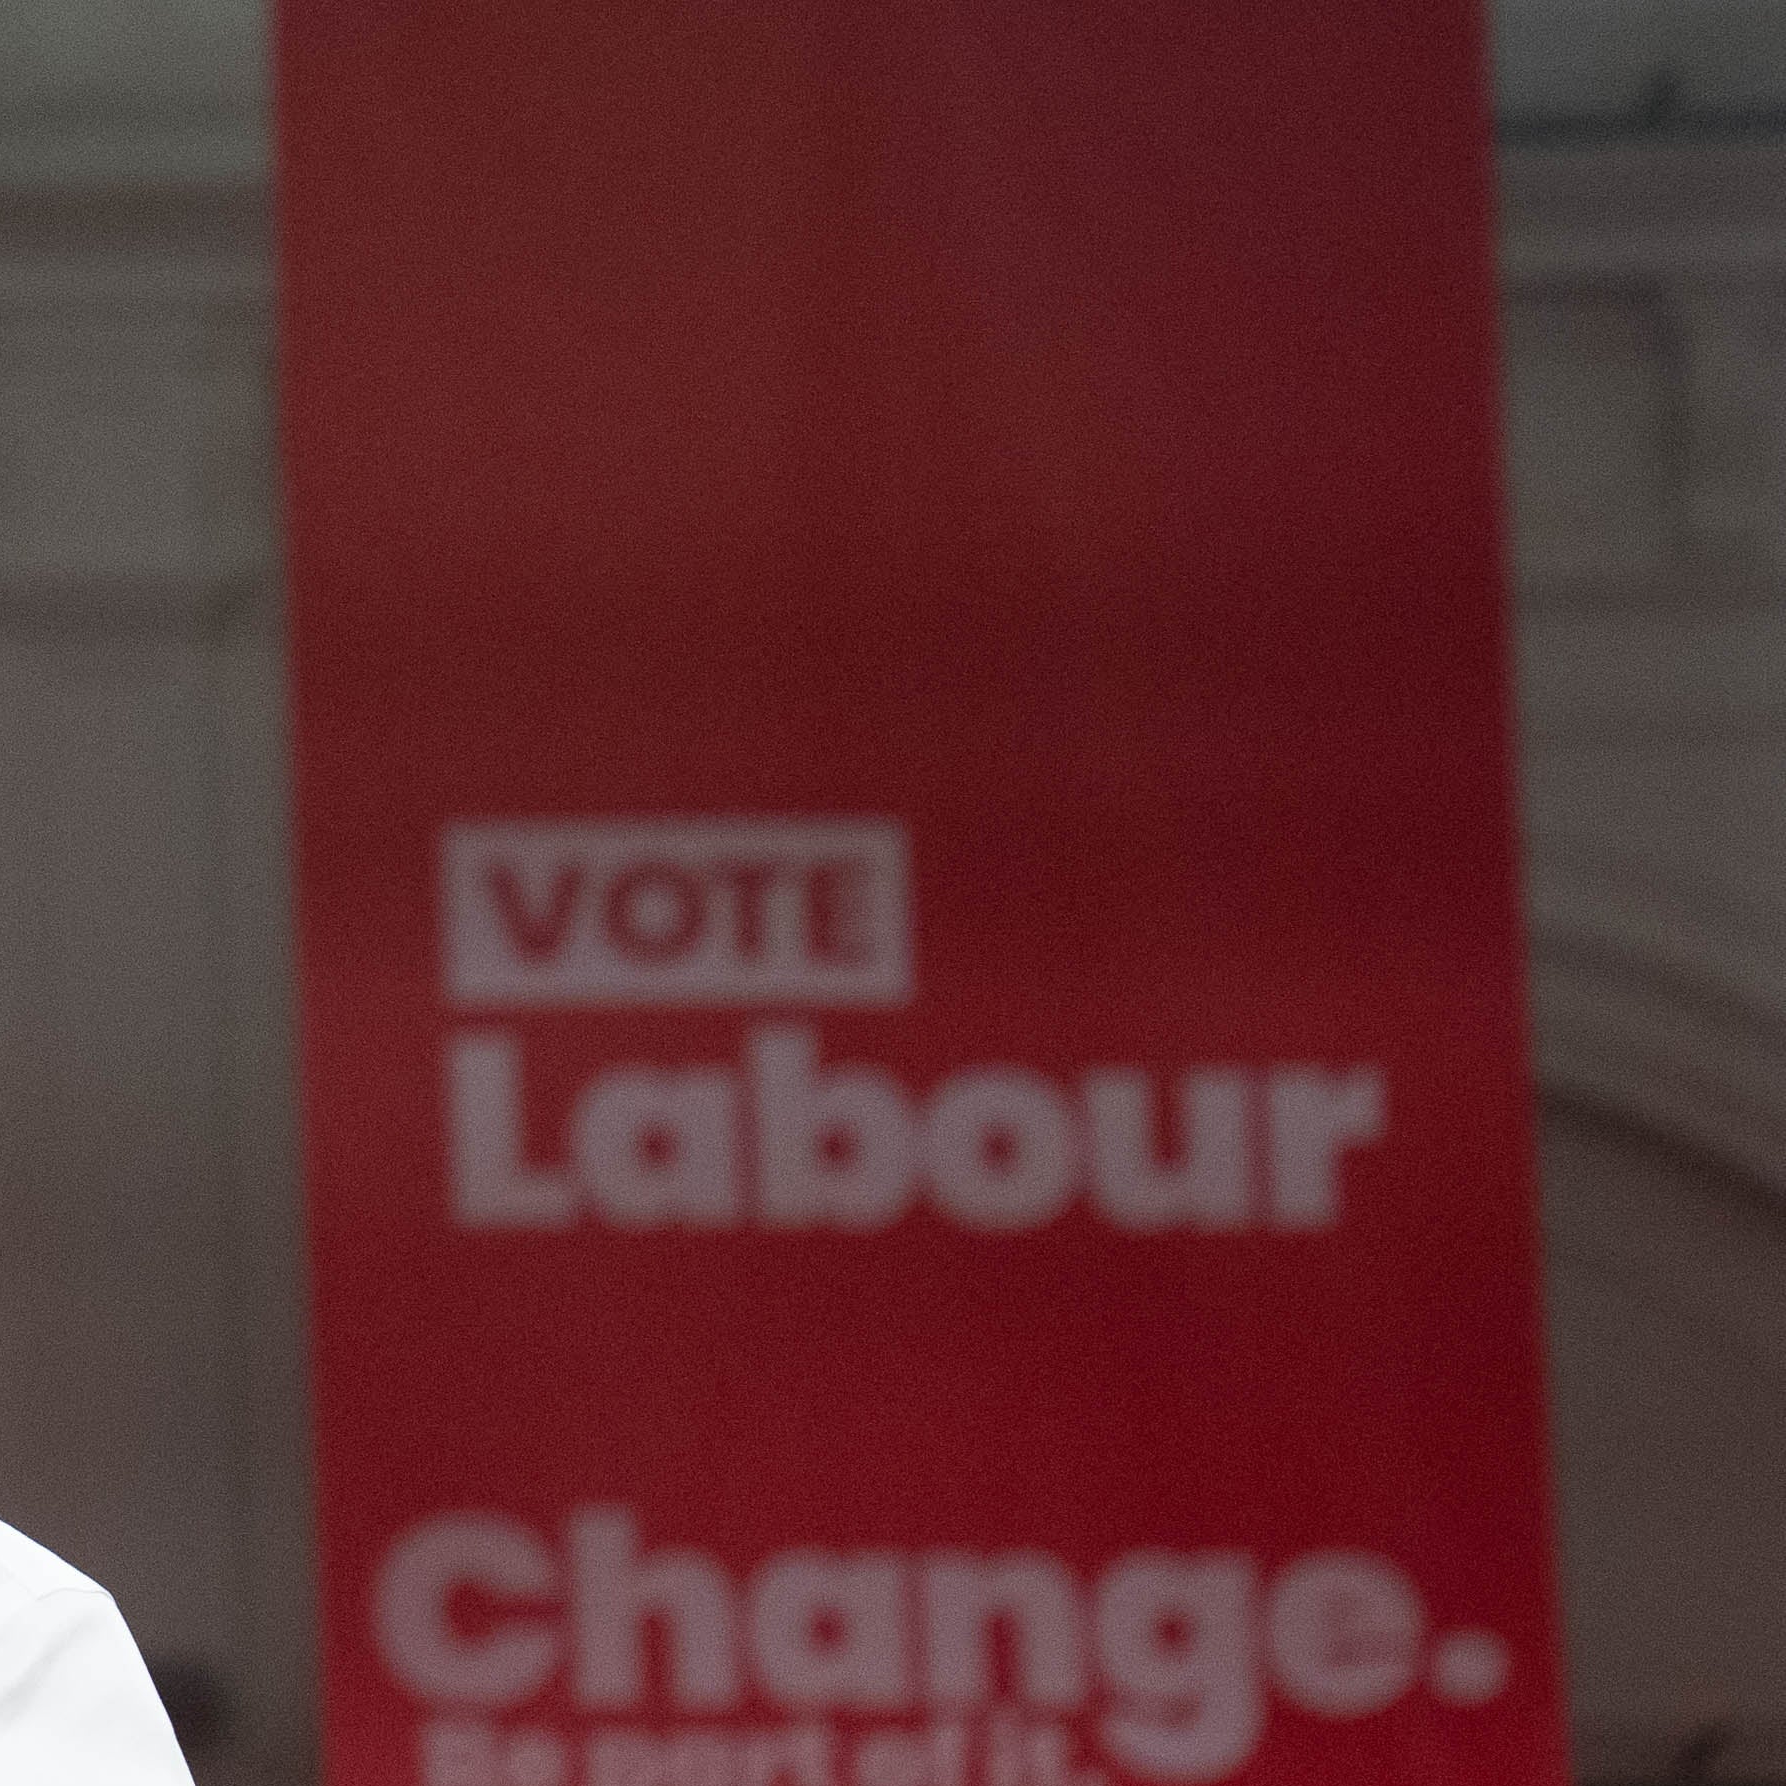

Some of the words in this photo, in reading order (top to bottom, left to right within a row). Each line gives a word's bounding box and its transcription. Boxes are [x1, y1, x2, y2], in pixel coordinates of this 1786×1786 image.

[483, 855, 868, 967] VOTE
[444, 1022, 1382, 1227] Labour
[373, 1506, 1504, 1786] Change.
